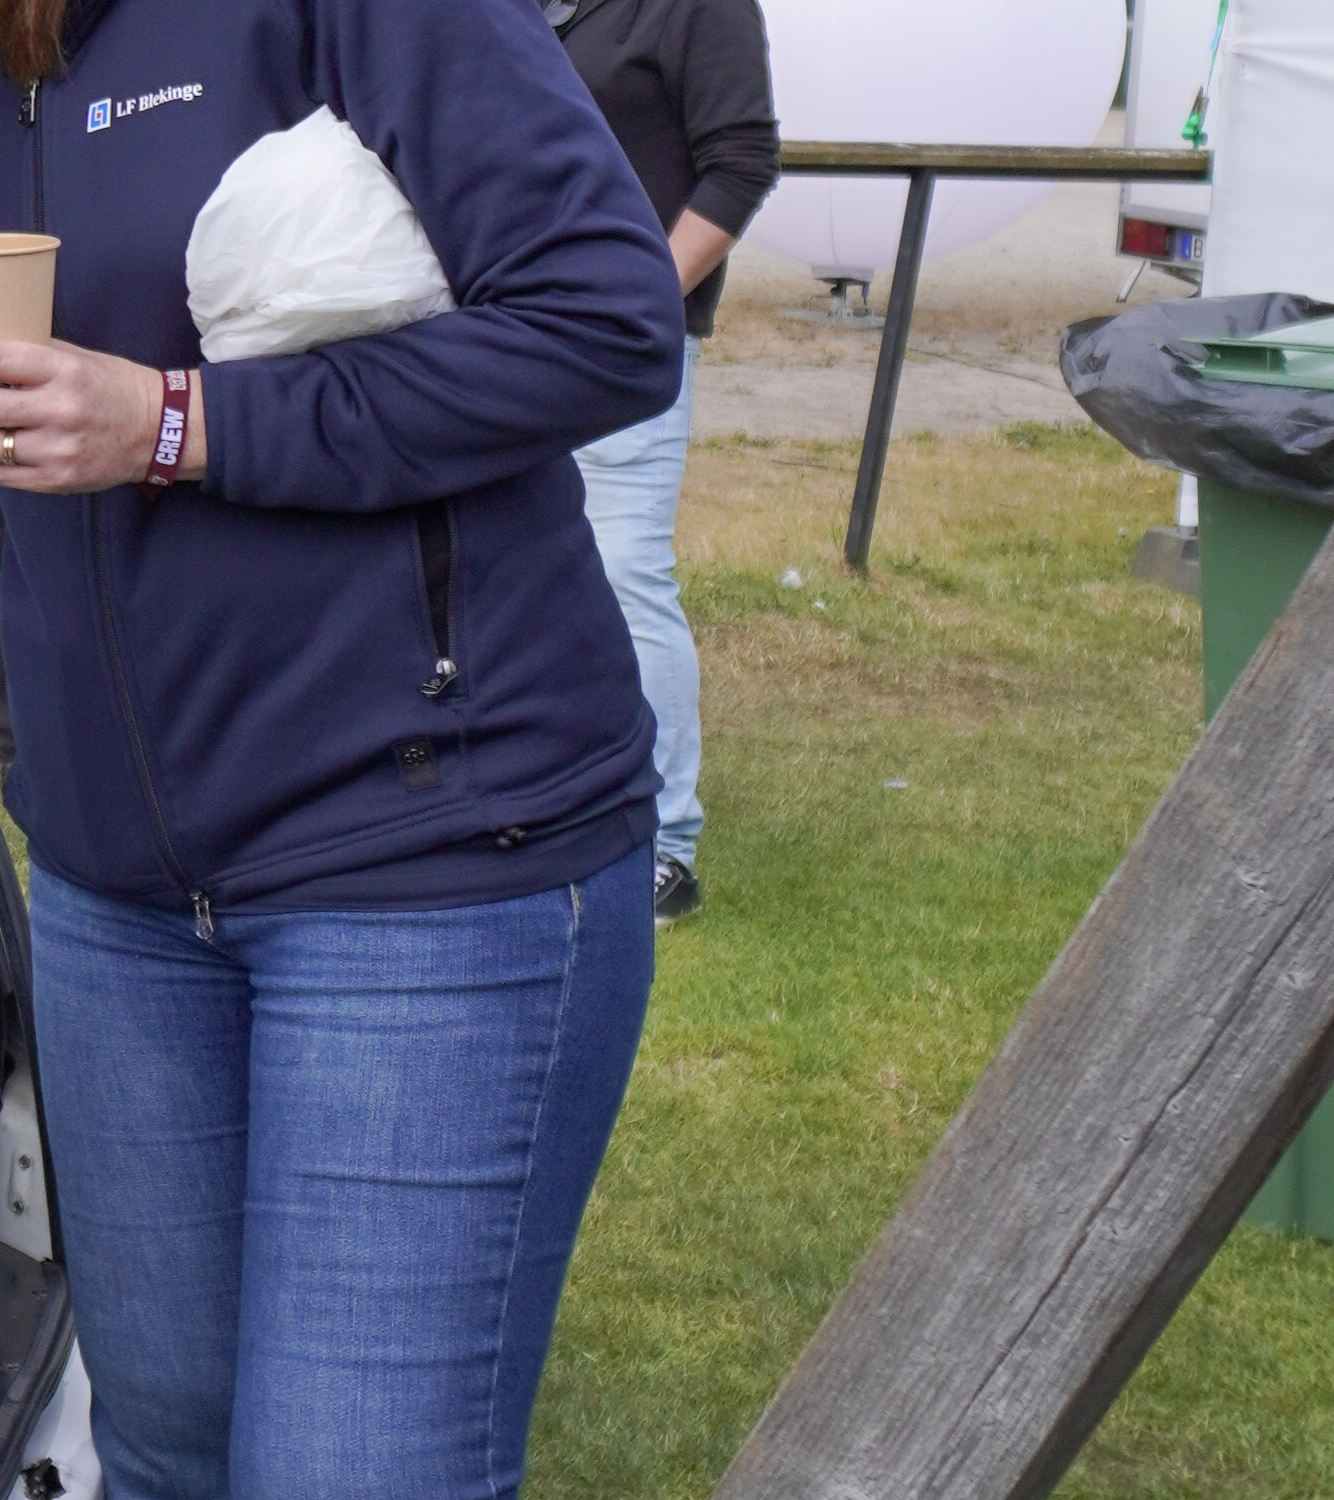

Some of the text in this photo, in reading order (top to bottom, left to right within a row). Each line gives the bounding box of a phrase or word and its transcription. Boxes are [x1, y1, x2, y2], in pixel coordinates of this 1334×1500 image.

[116, 83, 203, 118] LF Blekinge
[155, 407, 185, 466] CREW
